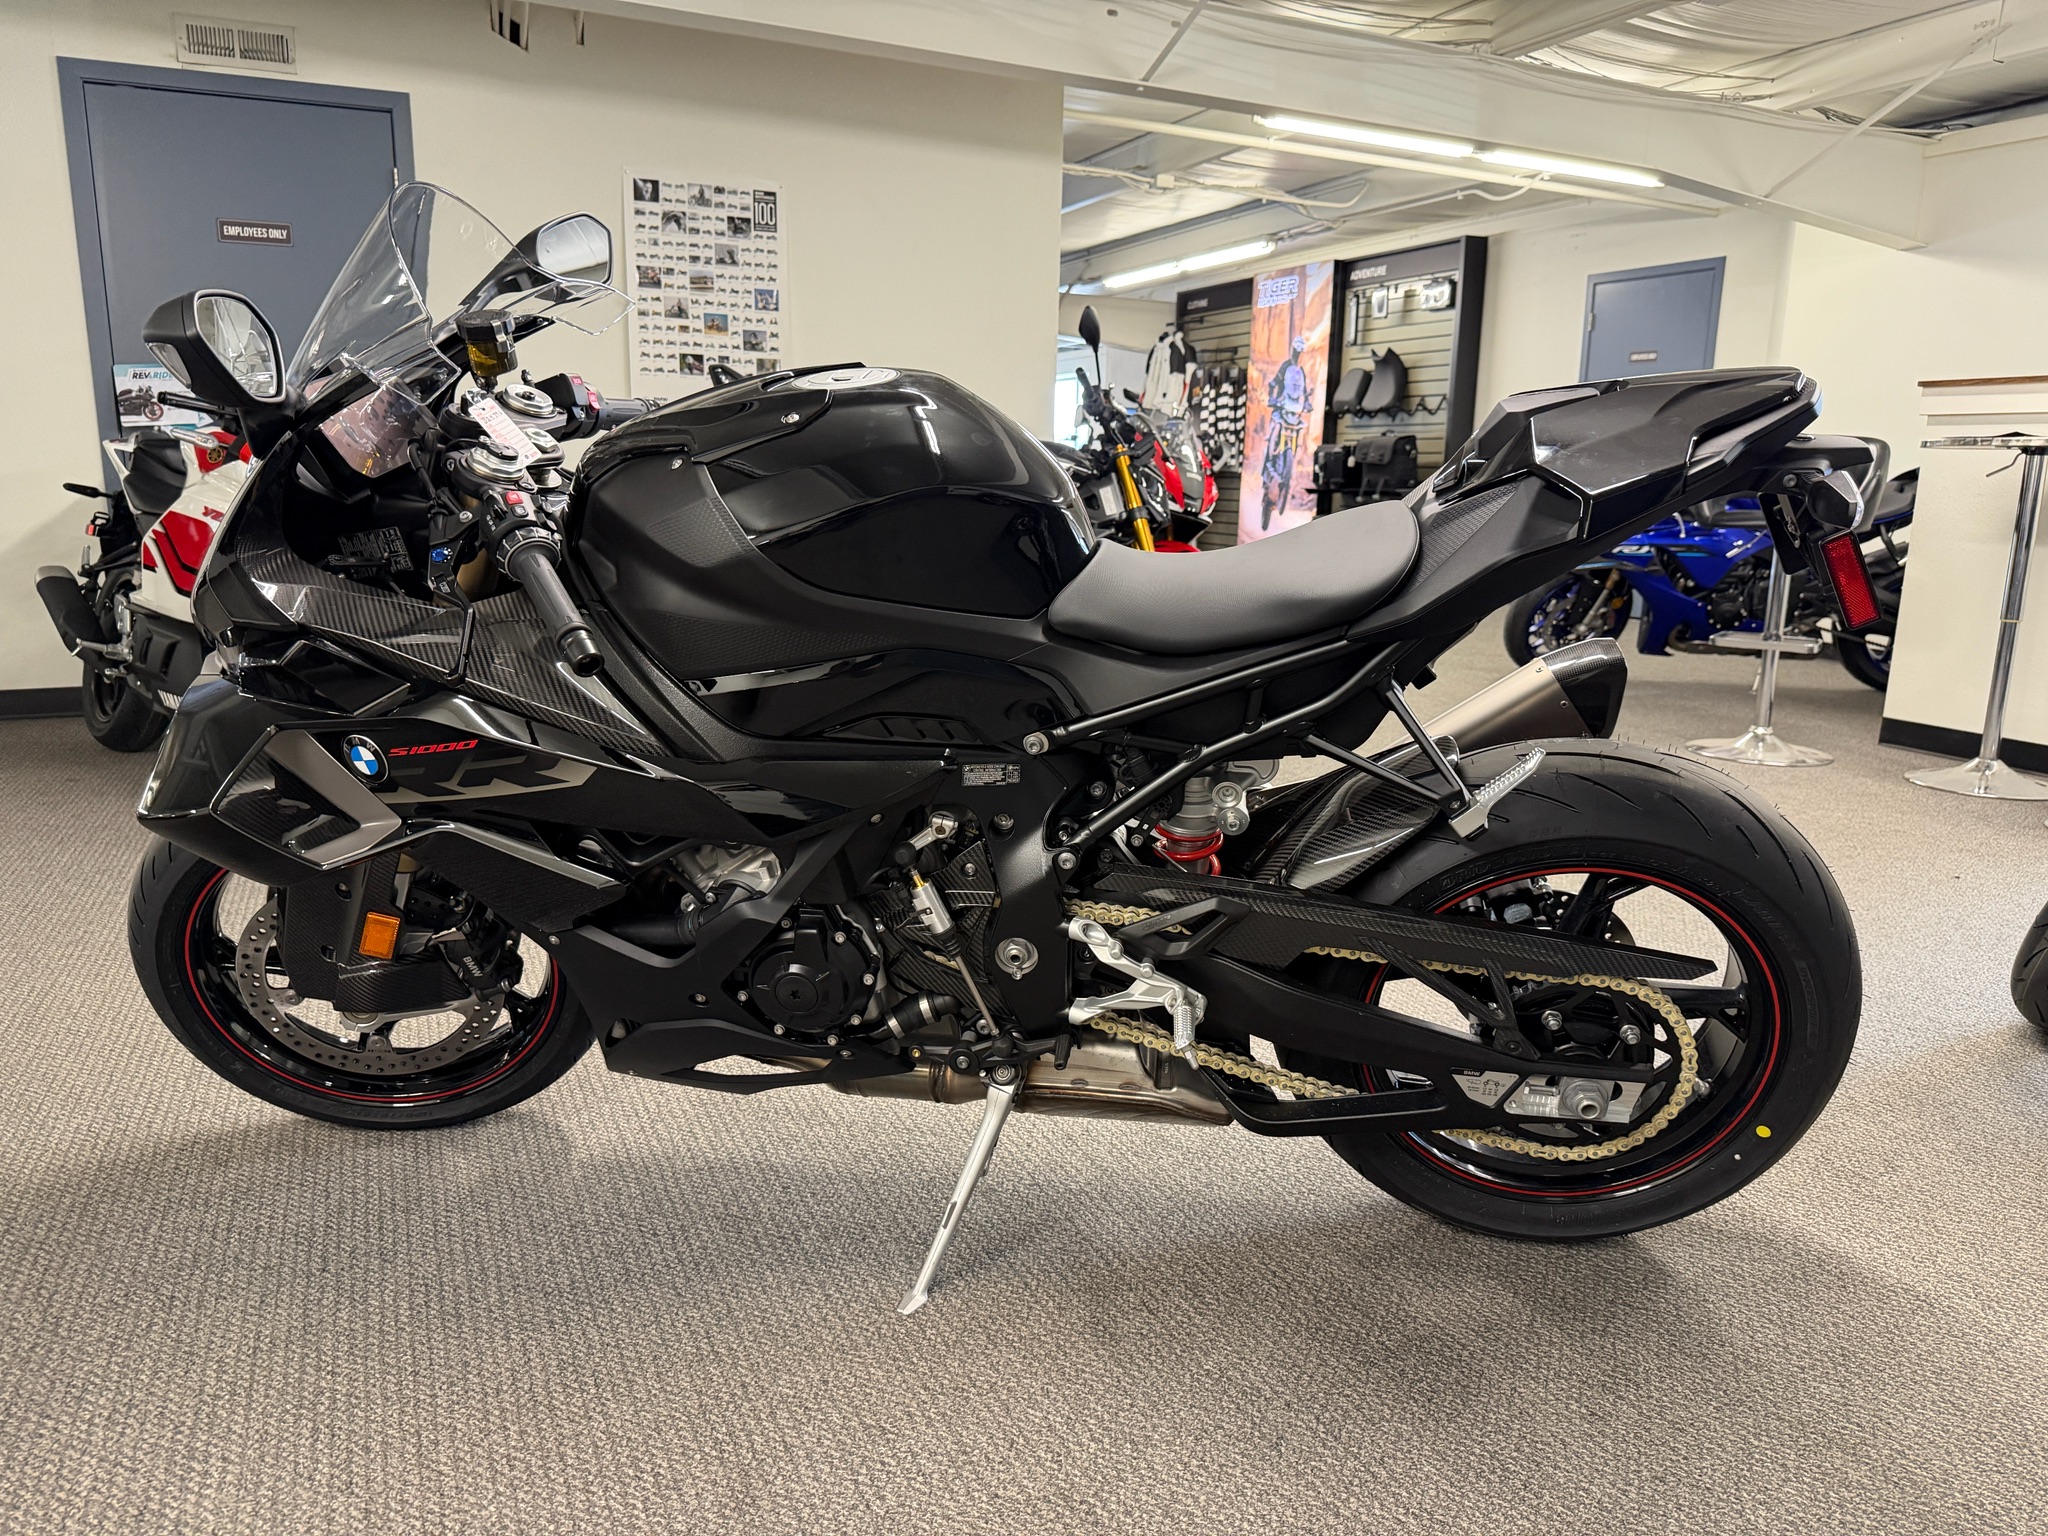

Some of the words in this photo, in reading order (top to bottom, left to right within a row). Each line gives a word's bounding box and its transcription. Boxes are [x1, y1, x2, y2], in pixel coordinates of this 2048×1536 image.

[754, 202, 776, 226] 100
[223, 225, 268, 238] EMPLOYEES
[268, 228, 288, 239] ONLY
[1349, 264, 1387, 281] ADVENTURE
[1257, 274, 1300, 298] TIGER
[132, 371, 151, 380] REV
[388, 739, 479, 757] S1000
[463, 956, 484, 977] BMW
